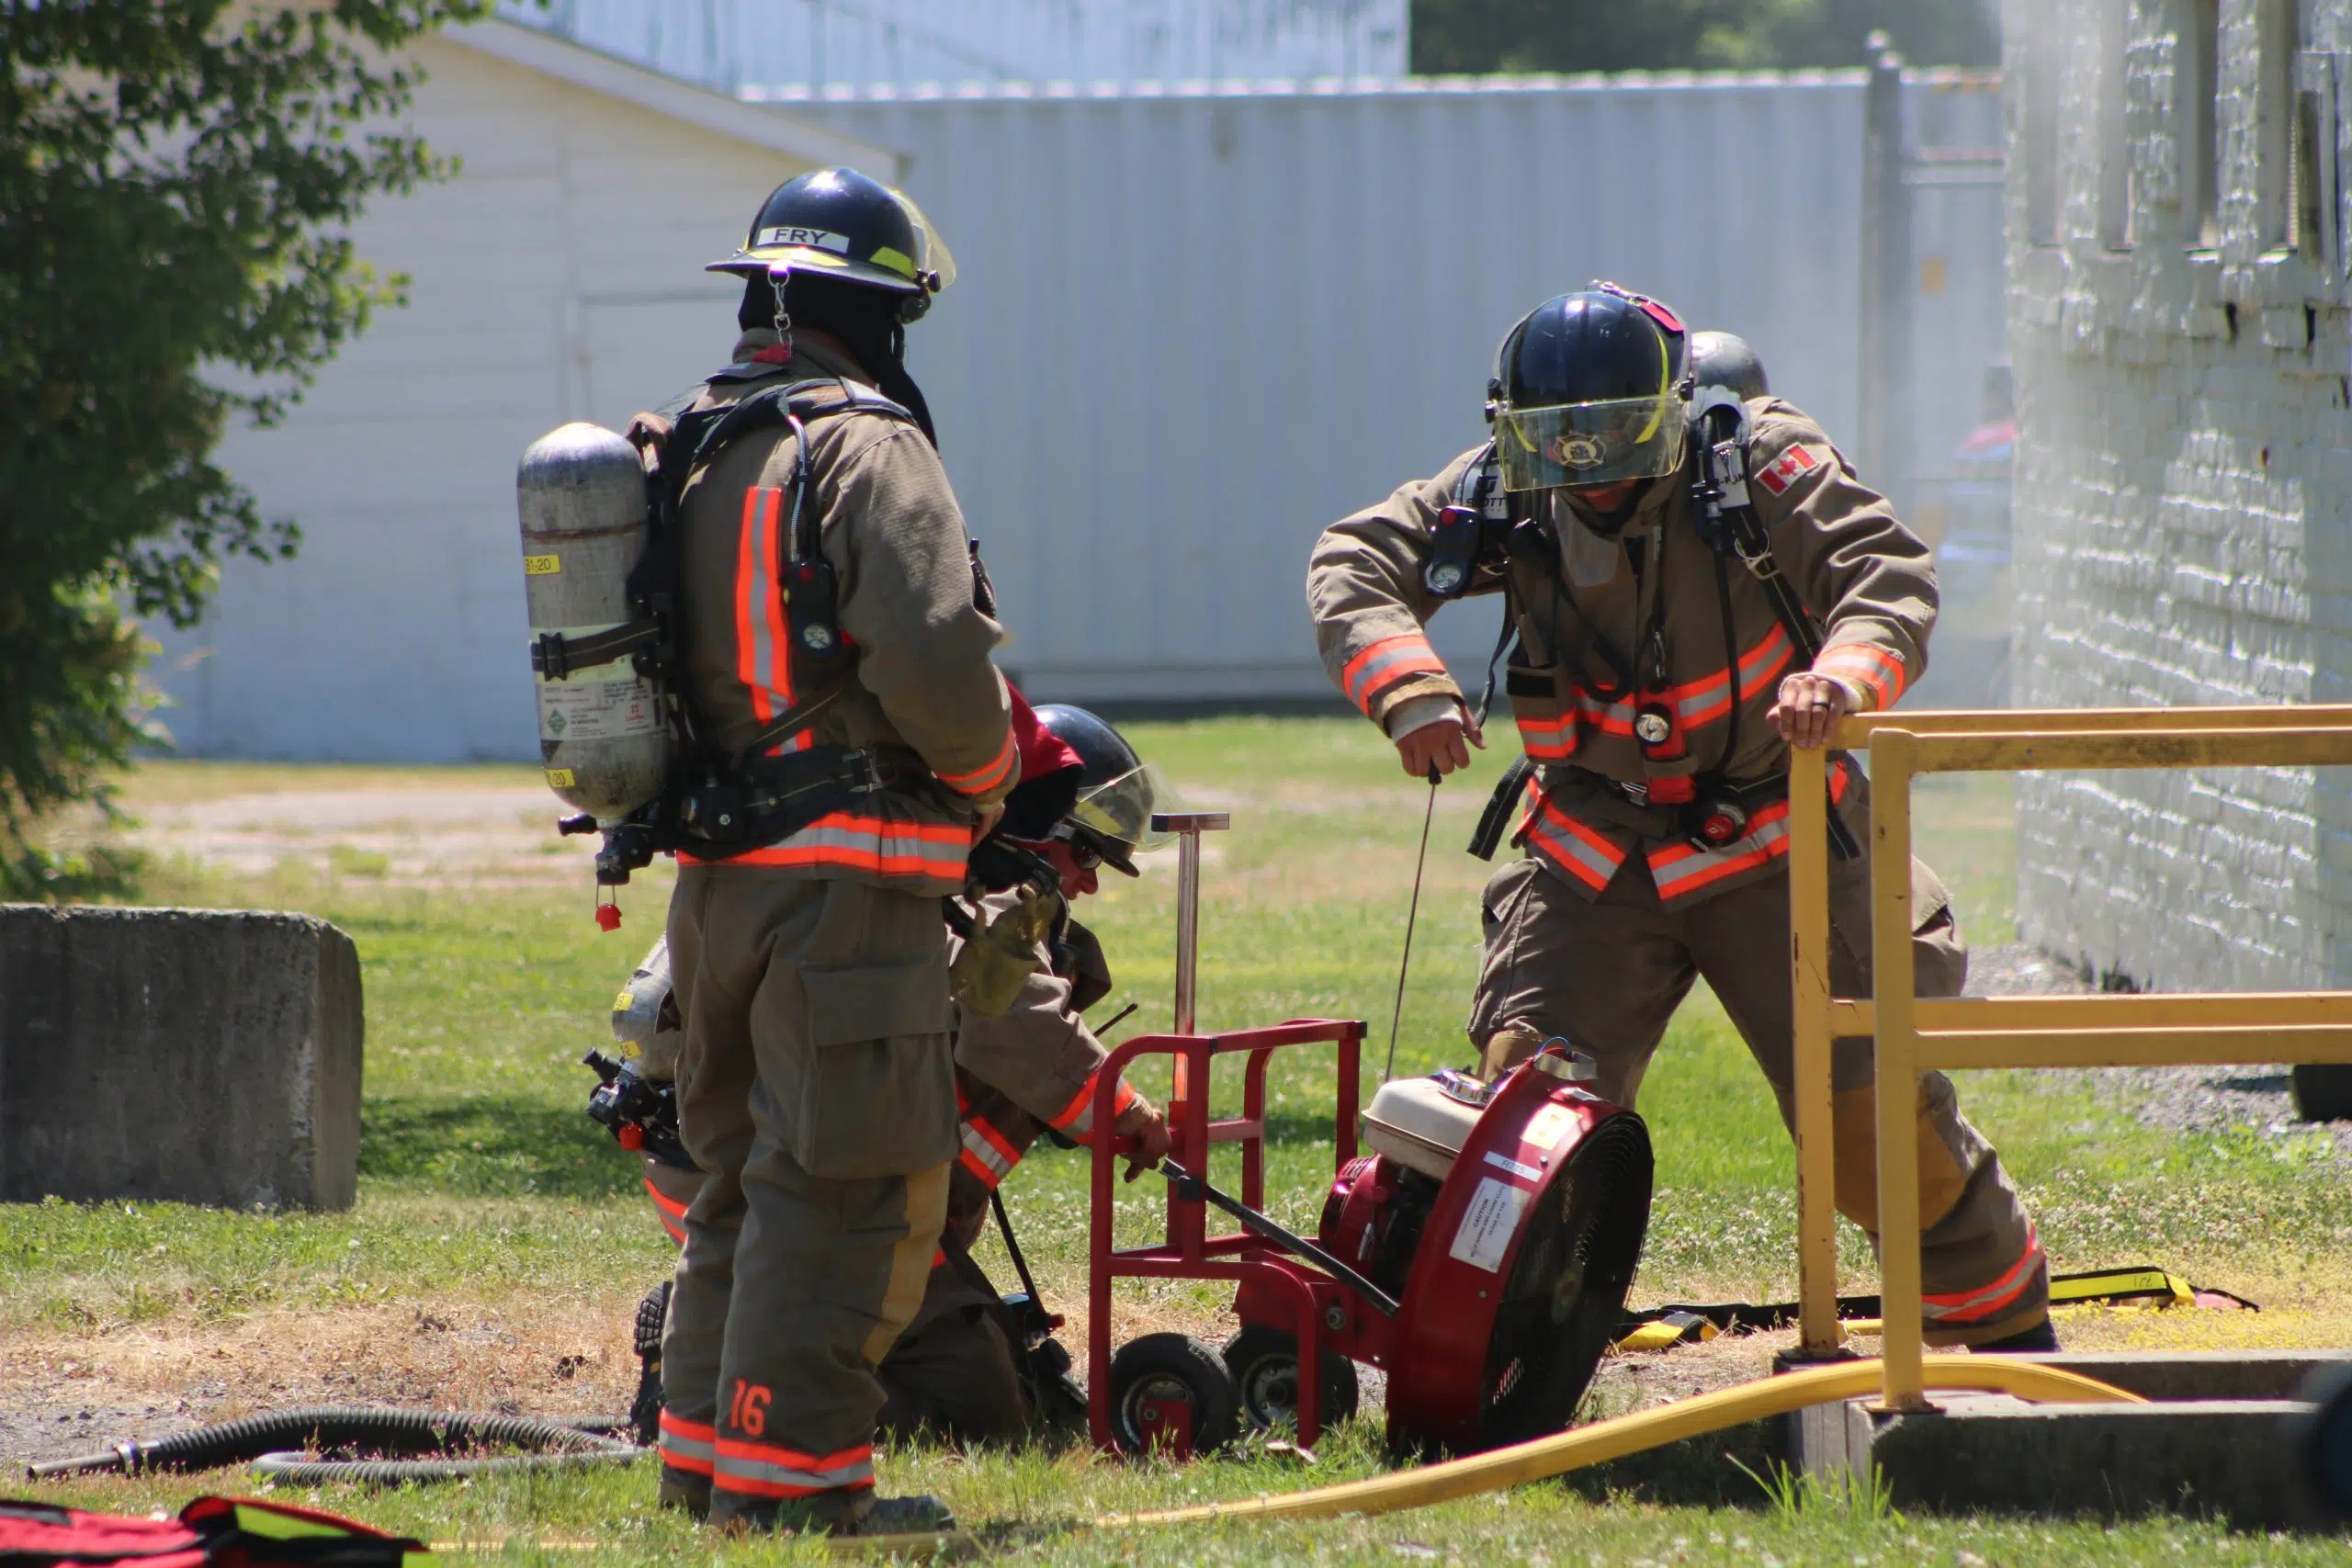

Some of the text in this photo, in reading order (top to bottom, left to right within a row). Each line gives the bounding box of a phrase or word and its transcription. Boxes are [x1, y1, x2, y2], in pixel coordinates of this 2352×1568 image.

[775, 229, 827, 244] FRY
[1474, 1199, 1489, 1228] CAUTION
[731, 1378, 772, 1435] 16
